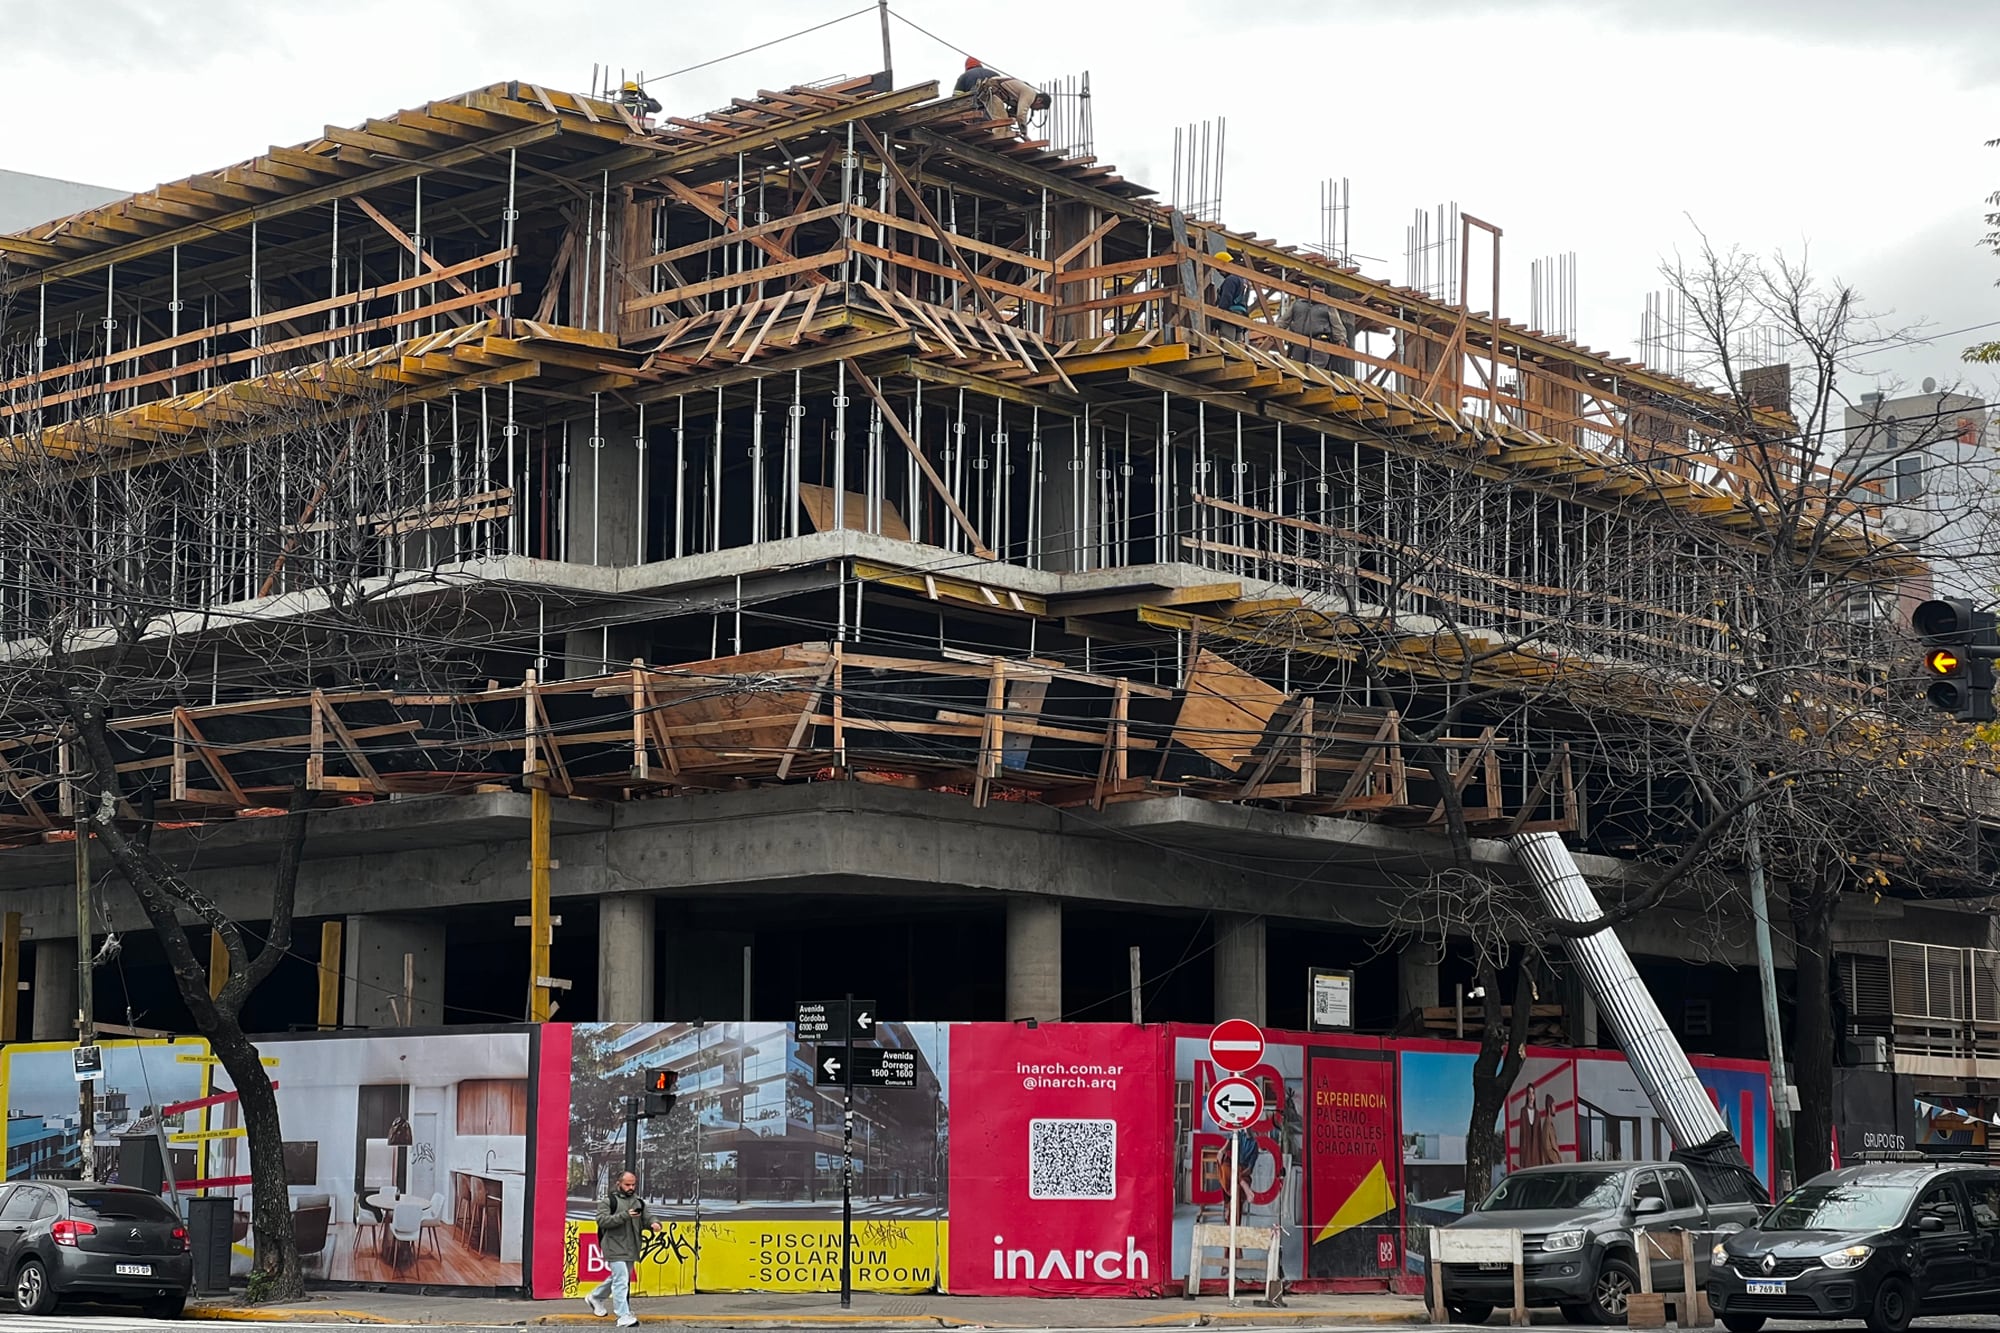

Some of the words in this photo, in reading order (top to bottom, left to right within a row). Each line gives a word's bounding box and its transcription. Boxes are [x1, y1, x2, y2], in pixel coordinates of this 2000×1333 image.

[799, 1004, 824, 1013] Avenida
[799, 1014, 825, 1022] Córdoba
[883, 1050, 913, 1060] Avenida
[882, 1060, 913, 1071] Dorrego
[1016, 1062, 1124, 1075] inarch.com.ar
[871, 1068, 889, 1078] 1500
[895, 1069, 914, 1078] 1600
[1023, 1077, 1117, 1091] @inarch.arq
[1316, 1074, 1329, 1089] LA
[1316, 1090, 1387, 1109] EXPERIENCIA
[1316, 1140, 1379, 1156] CHACARITA
[749, 1250, 887, 1265] -SOLARUM
[859, 1267, 931, 1282] ROOM
[1759, 1285, 1773, 1293] 769
